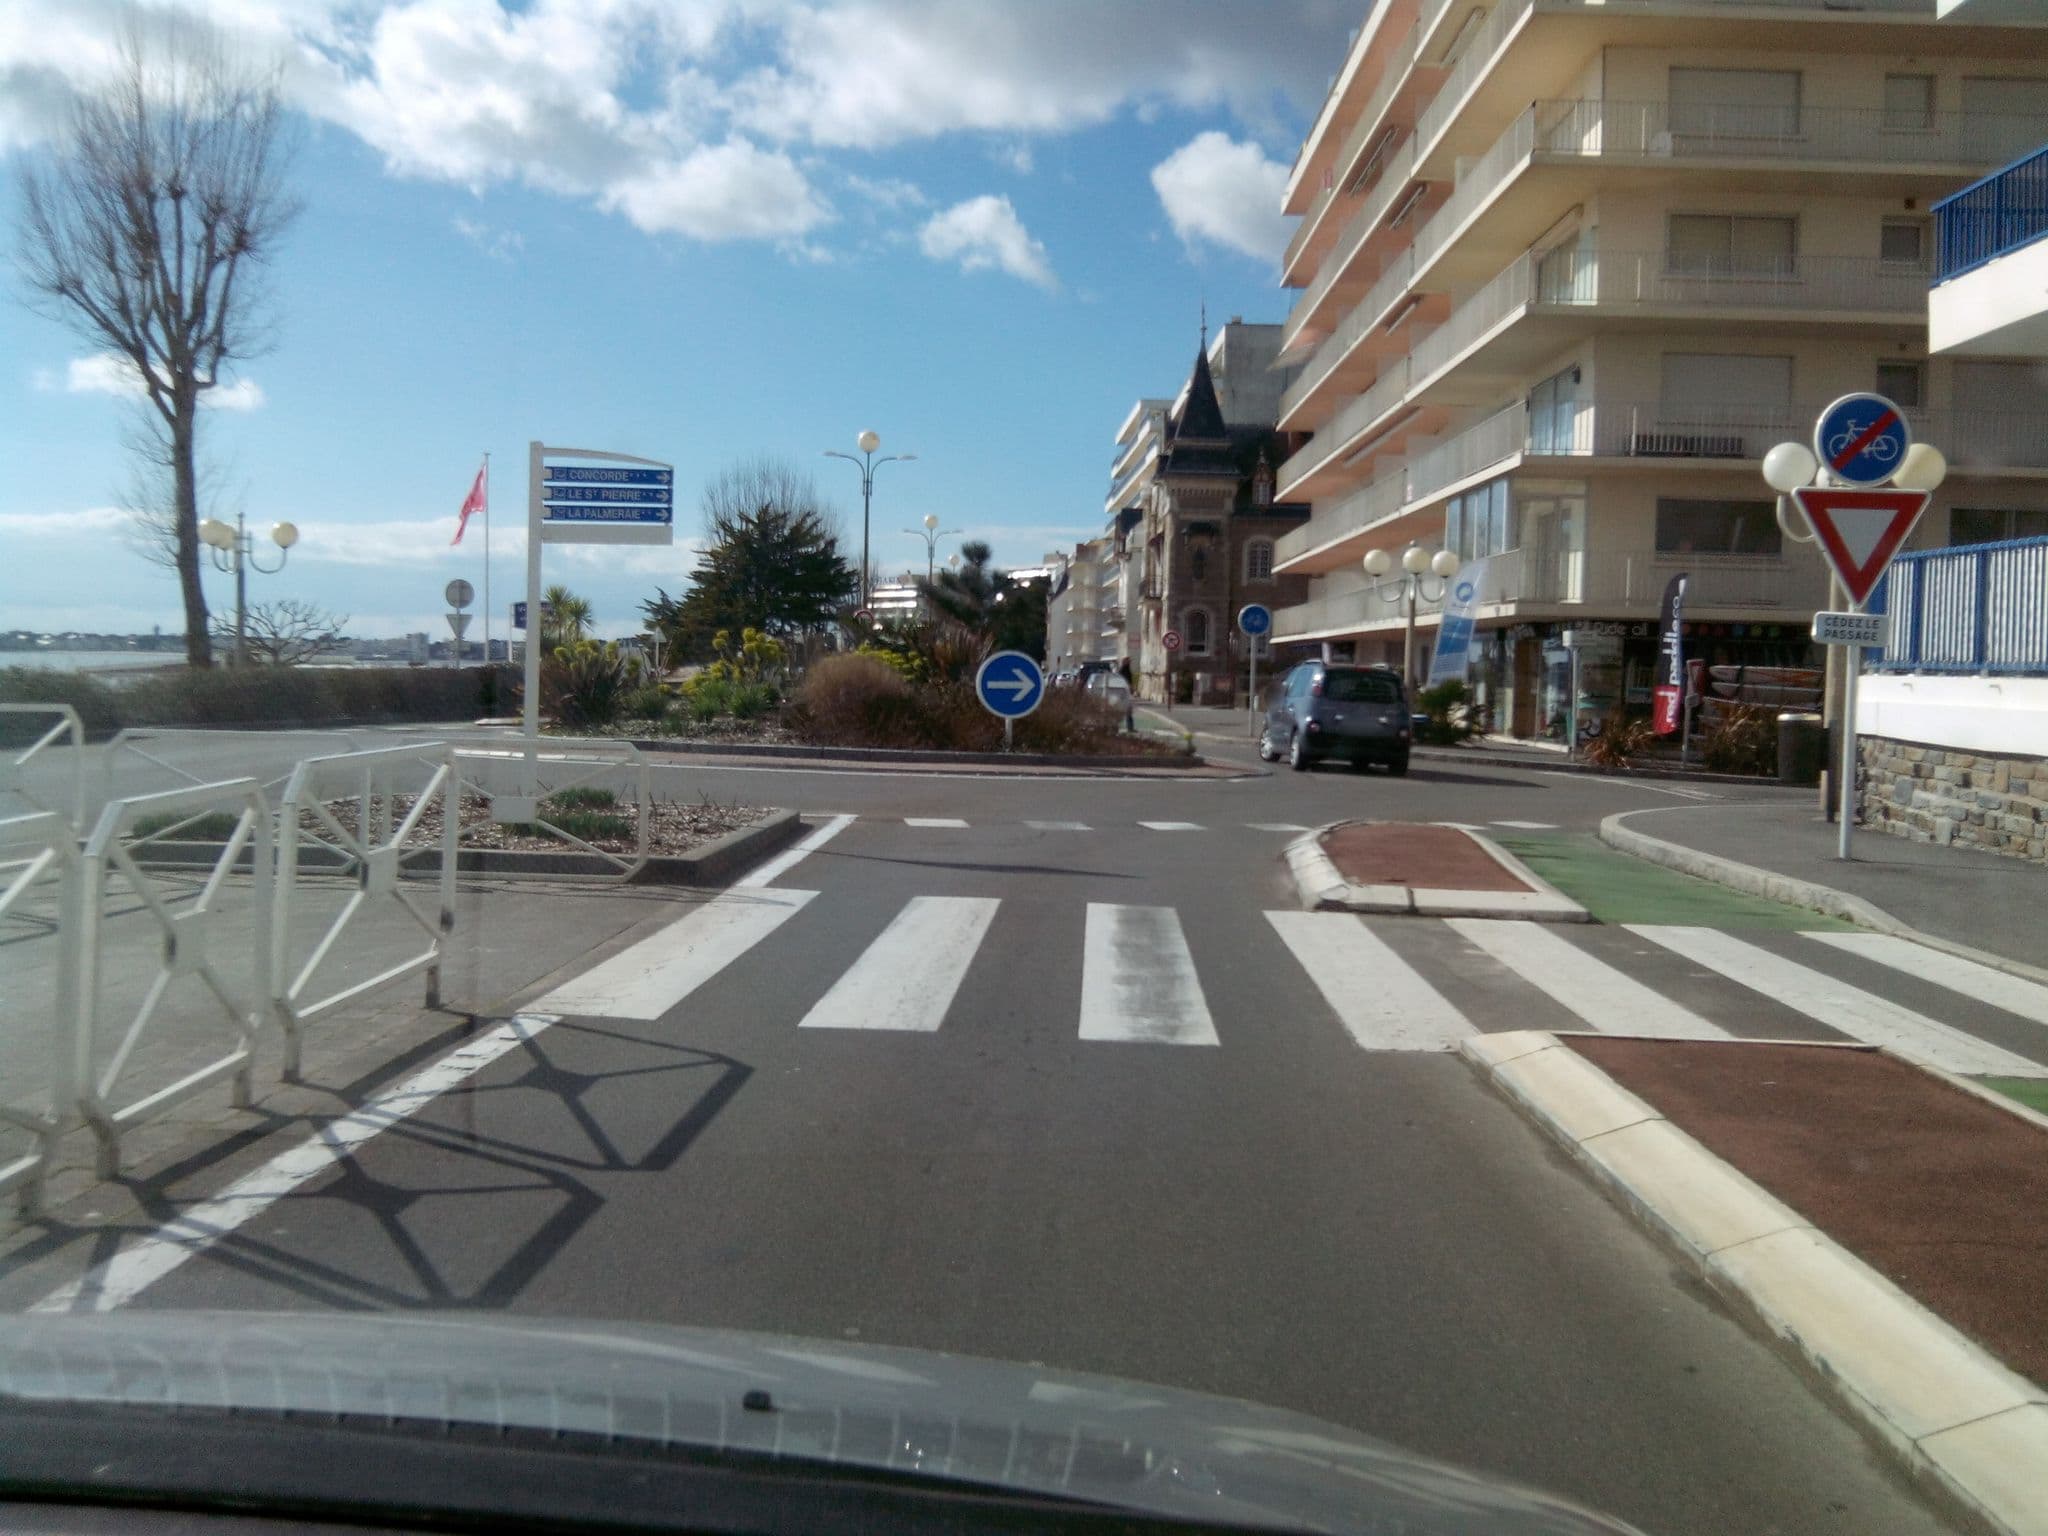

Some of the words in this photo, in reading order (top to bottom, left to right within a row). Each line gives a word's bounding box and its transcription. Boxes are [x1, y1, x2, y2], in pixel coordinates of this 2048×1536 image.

[569, 470, 629, 481] CONCORDE
[568, 489, 583, 499] LE
[602, 489, 641, 501] PIERRE
[568, 507, 581, 518] LA
[584, 507, 641, 519] PALMERAIE
[1865, 619, 1880, 629] LE
[1824, 629, 1878, 641] PASSAGE
[1656, 691, 1677, 723] red
